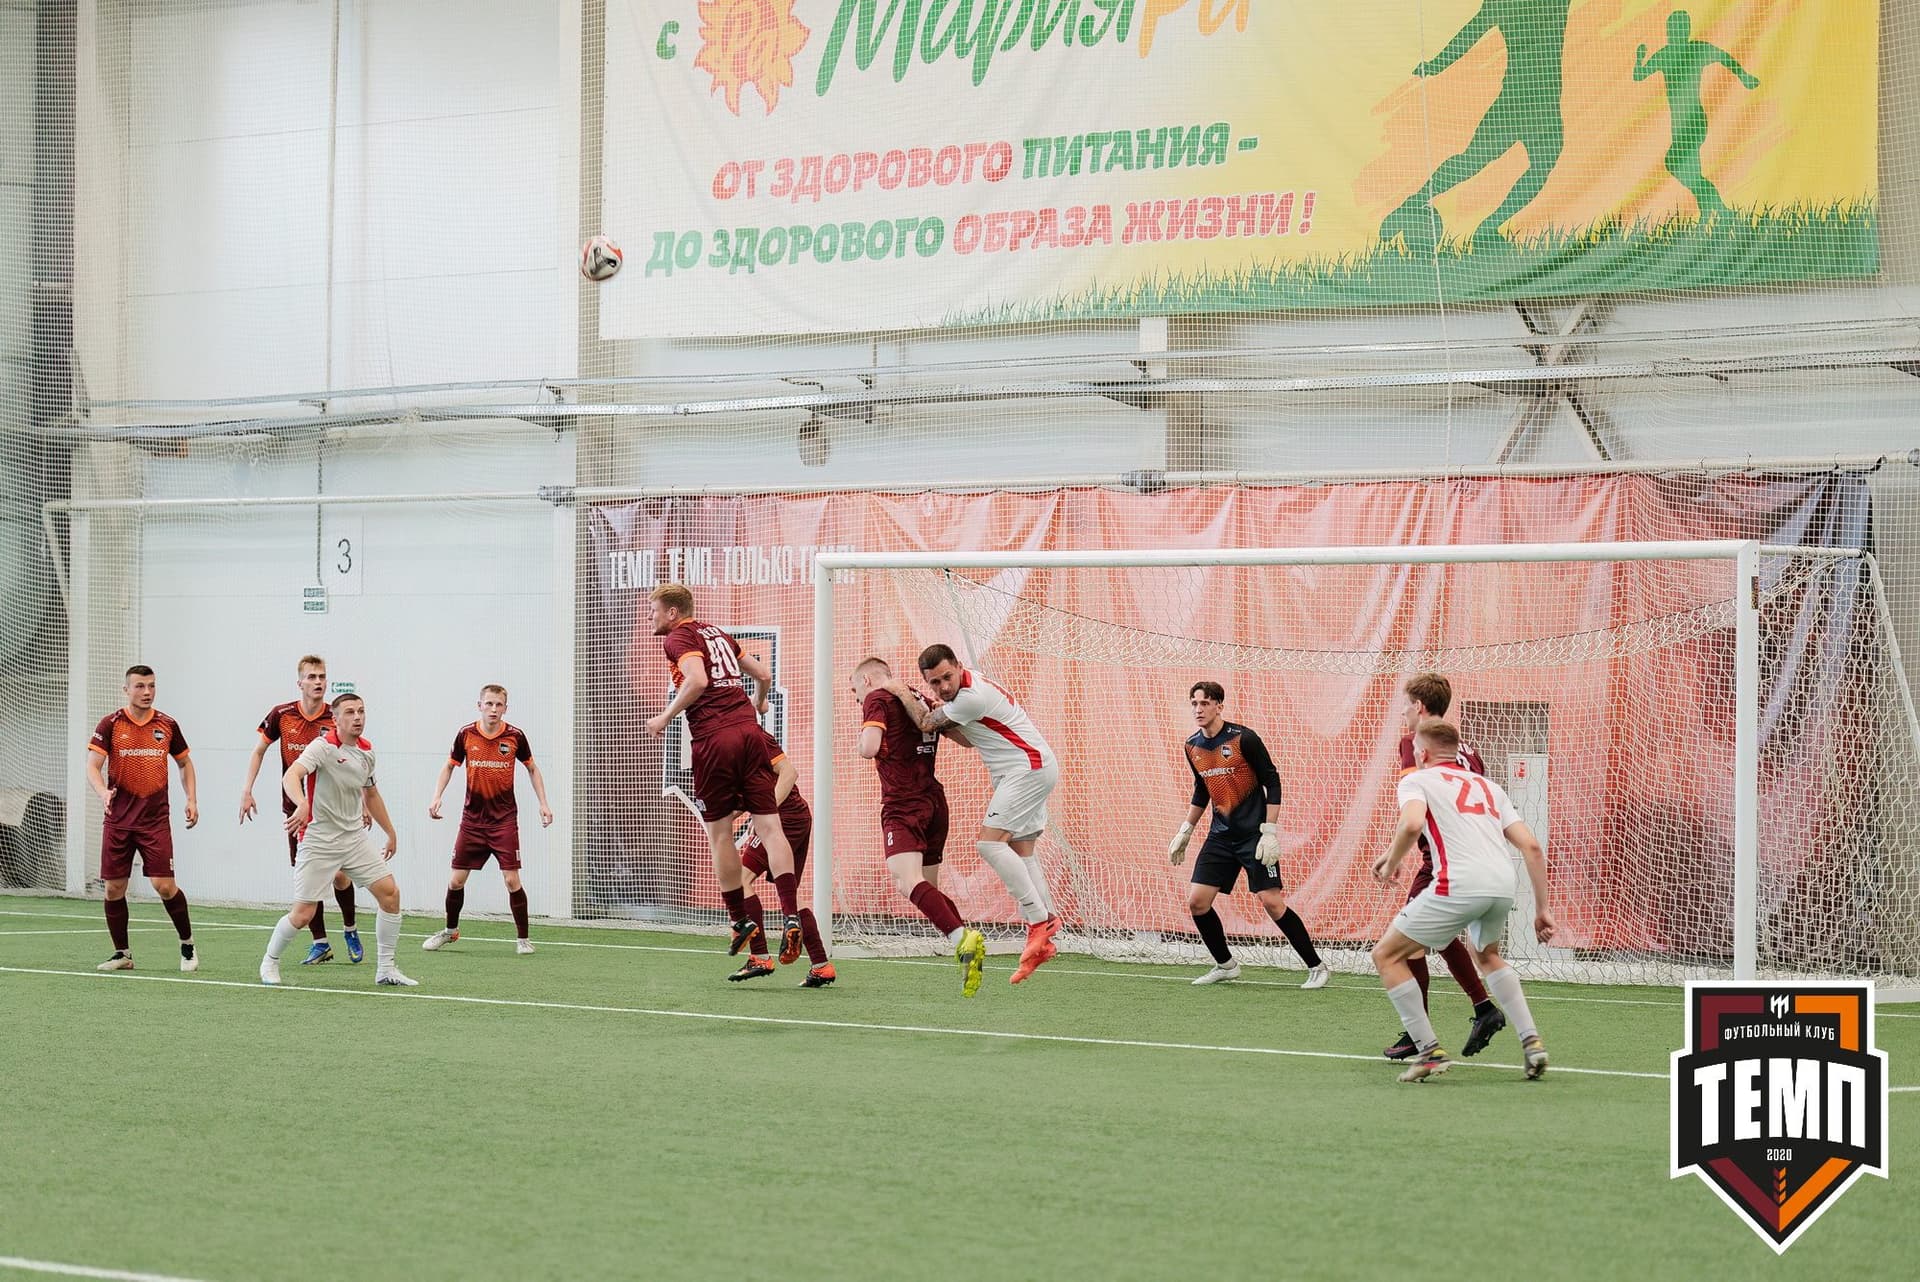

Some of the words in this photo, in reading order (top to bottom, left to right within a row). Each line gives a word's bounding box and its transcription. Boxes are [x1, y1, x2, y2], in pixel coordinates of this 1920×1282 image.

[711, 160, 767, 200] ОТ
[769, 140, 1014, 205] ЗДОРОВОГО
[1021, 121, 1231, 181] ПИТАНИЯ
[644, 229, 704, 279] ДО
[707, 215, 946, 276] ЗДОРОВОГО
[953, 203, 1114, 256] ОБРАЗА
[337, 537, 353, 575] 3
[665, 546, 719, 591] ТЕМП,
[722, 544, 794, 586] ТОЛЬКО
[796, 543, 857, 585] ТЕП!
[704, 635, 741, 679] 90
[1439, 771, 1502, 821] 21
[887, 831, 894, 847] 2
